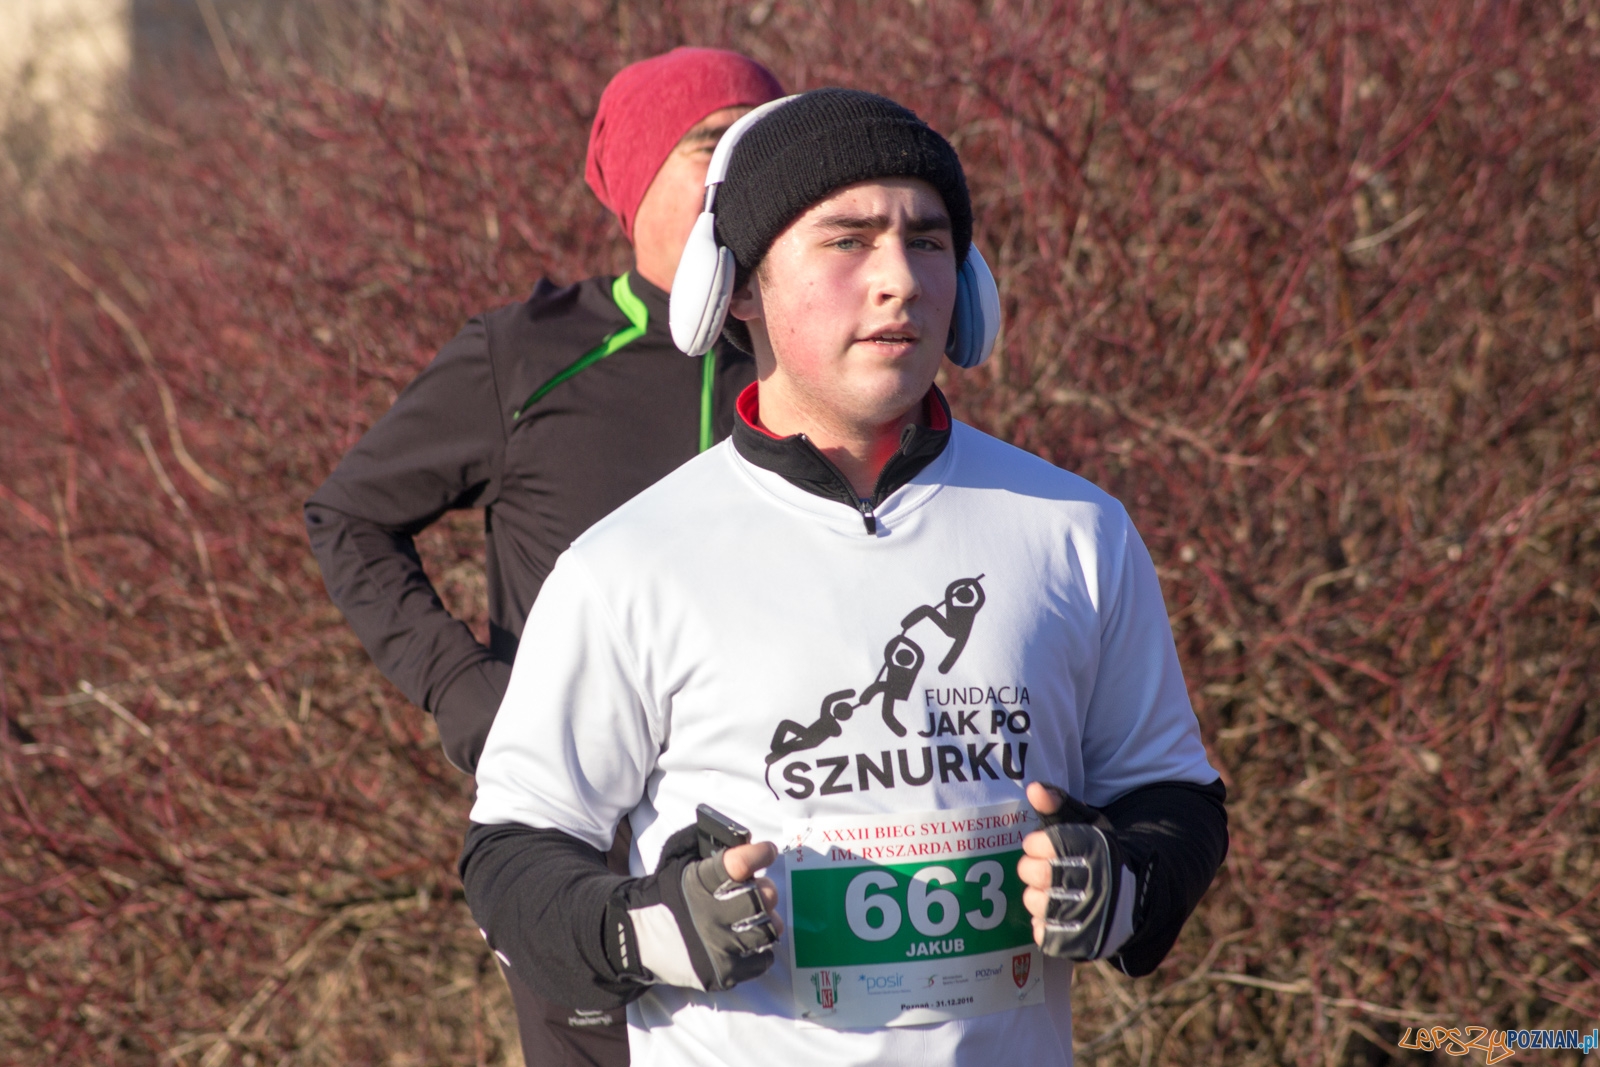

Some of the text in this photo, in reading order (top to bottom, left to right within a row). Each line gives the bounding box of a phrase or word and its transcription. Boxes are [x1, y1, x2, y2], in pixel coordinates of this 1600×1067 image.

[924, 686, 1031, 707] FUNDACJA
[917, 709, 1031, 738] JAK PO
[782, 742, 1029, 800] SZNURKU
[822, 810, 1029, 843] XXXII BIEG SYLWESTROWY
[831, 830, 1024, 862] IM. RYSZARDA BURGIELA
[845, 860, 1008, 941] 663
[905, 938, 965, 958] JAKUB
